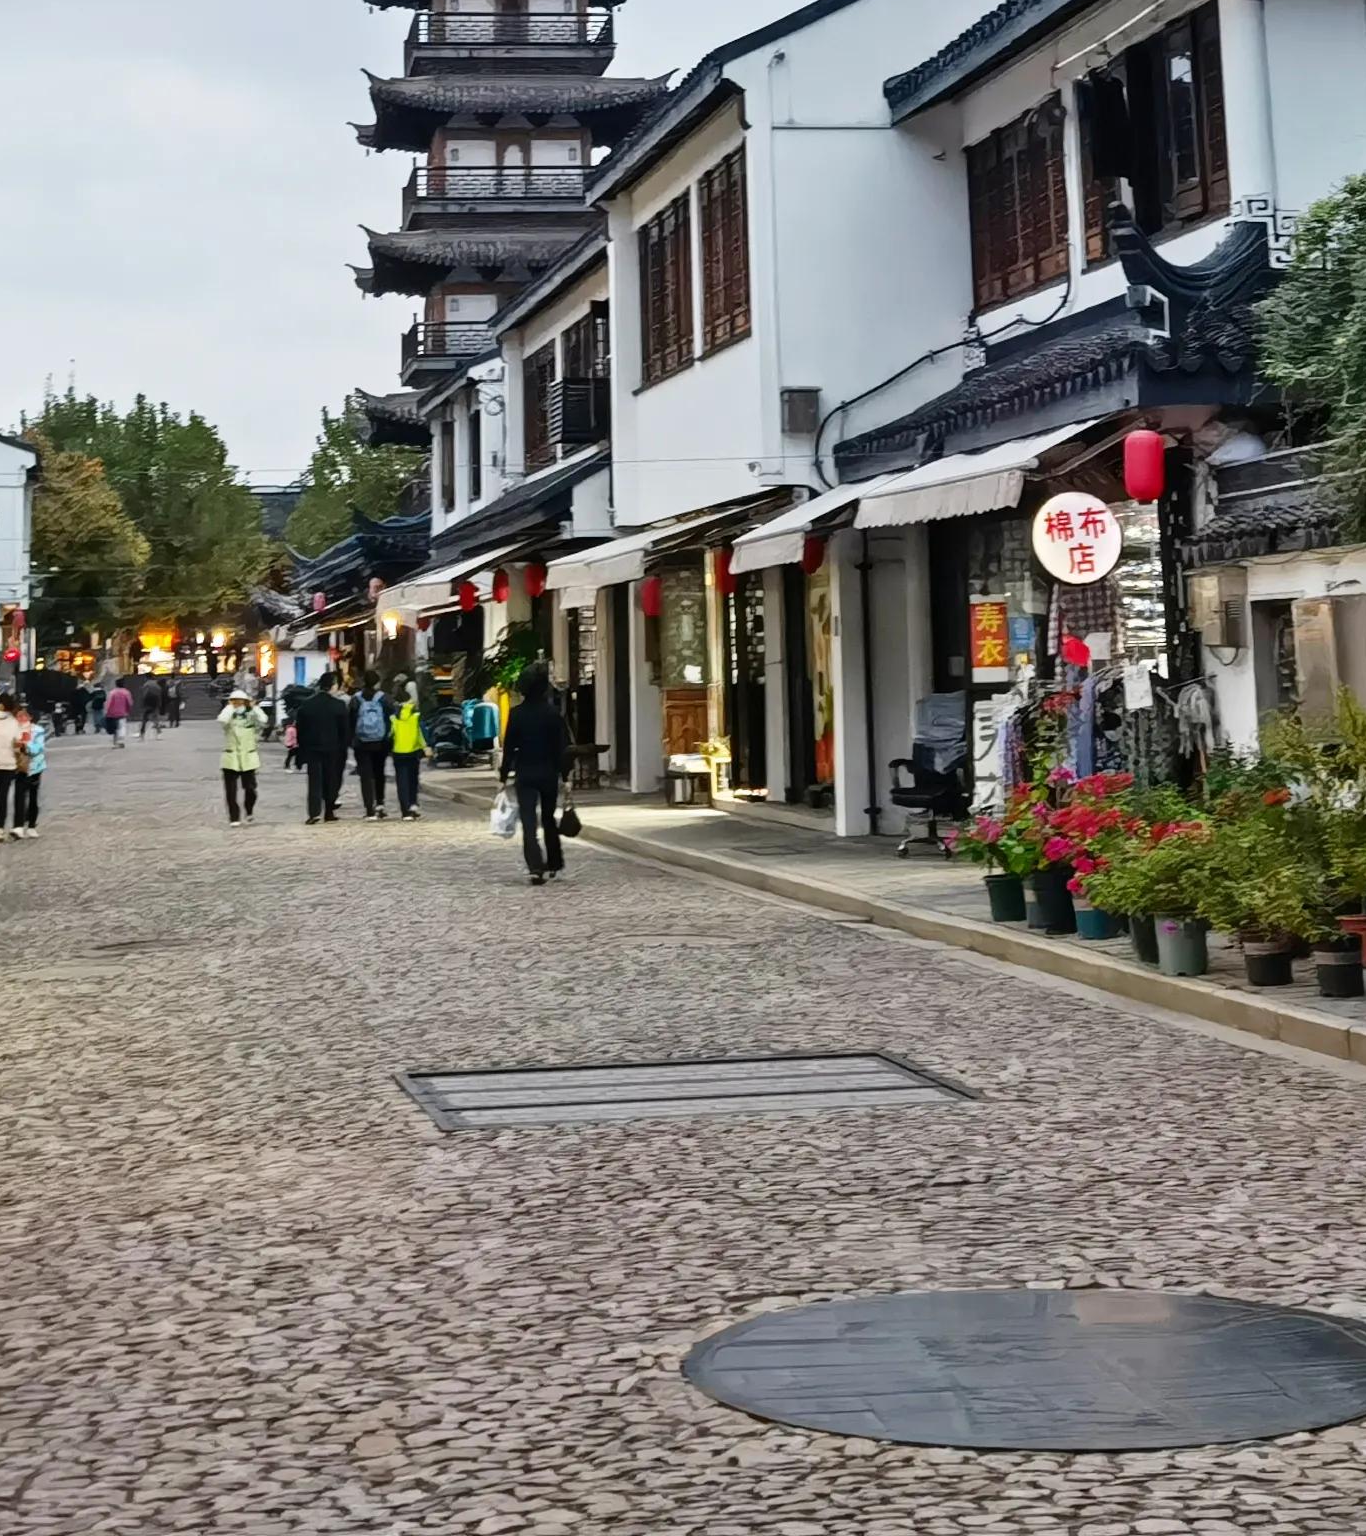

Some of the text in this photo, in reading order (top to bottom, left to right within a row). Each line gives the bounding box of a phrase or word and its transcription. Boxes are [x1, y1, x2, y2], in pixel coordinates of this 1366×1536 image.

[1045, 508, 1107, 542] 棉布
[1069, 543, 1096, 574] 店
[975, 603, 1005, 663] 寿衣
